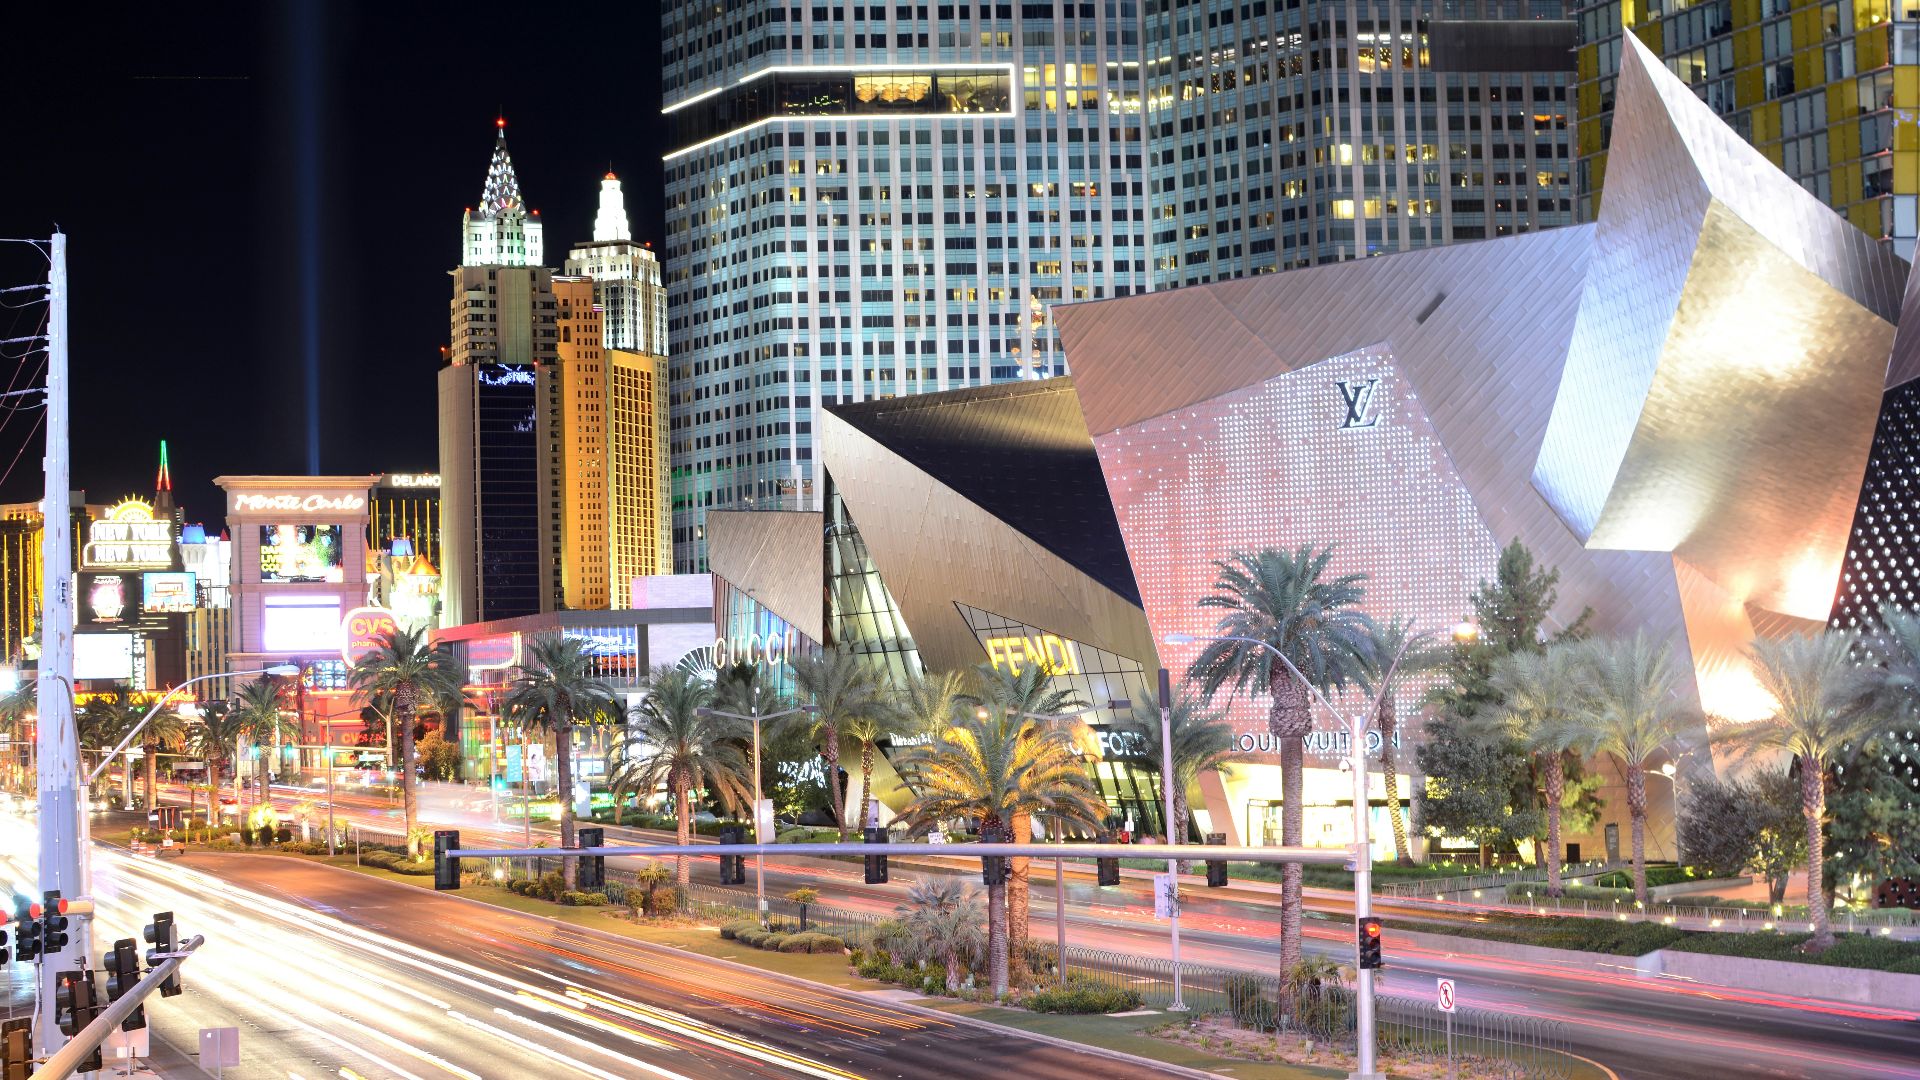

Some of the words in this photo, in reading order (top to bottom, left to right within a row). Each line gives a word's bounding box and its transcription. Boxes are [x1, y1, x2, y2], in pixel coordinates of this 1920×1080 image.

[391, 475, 441, 487] DELANO
[235, 494, 301, 510] Monte
[302, 494, 364, 511] Carlo
[94, 523, 129, 541] NEW
[130, 523, 171, 541] YORK
[95, 544, 129, 562] NEW
[130, 544, 171, 562] YORK
[351, 618, 393, 636] CVS
[352, 640, 392, 649] pharm
[714, 631, 790, 670] GUCCI
[986, 635, 1080, 678] FENDI
[1231, 733, 1281, 751] LOUI
[1302, 731, 1400, 751] VUITON
